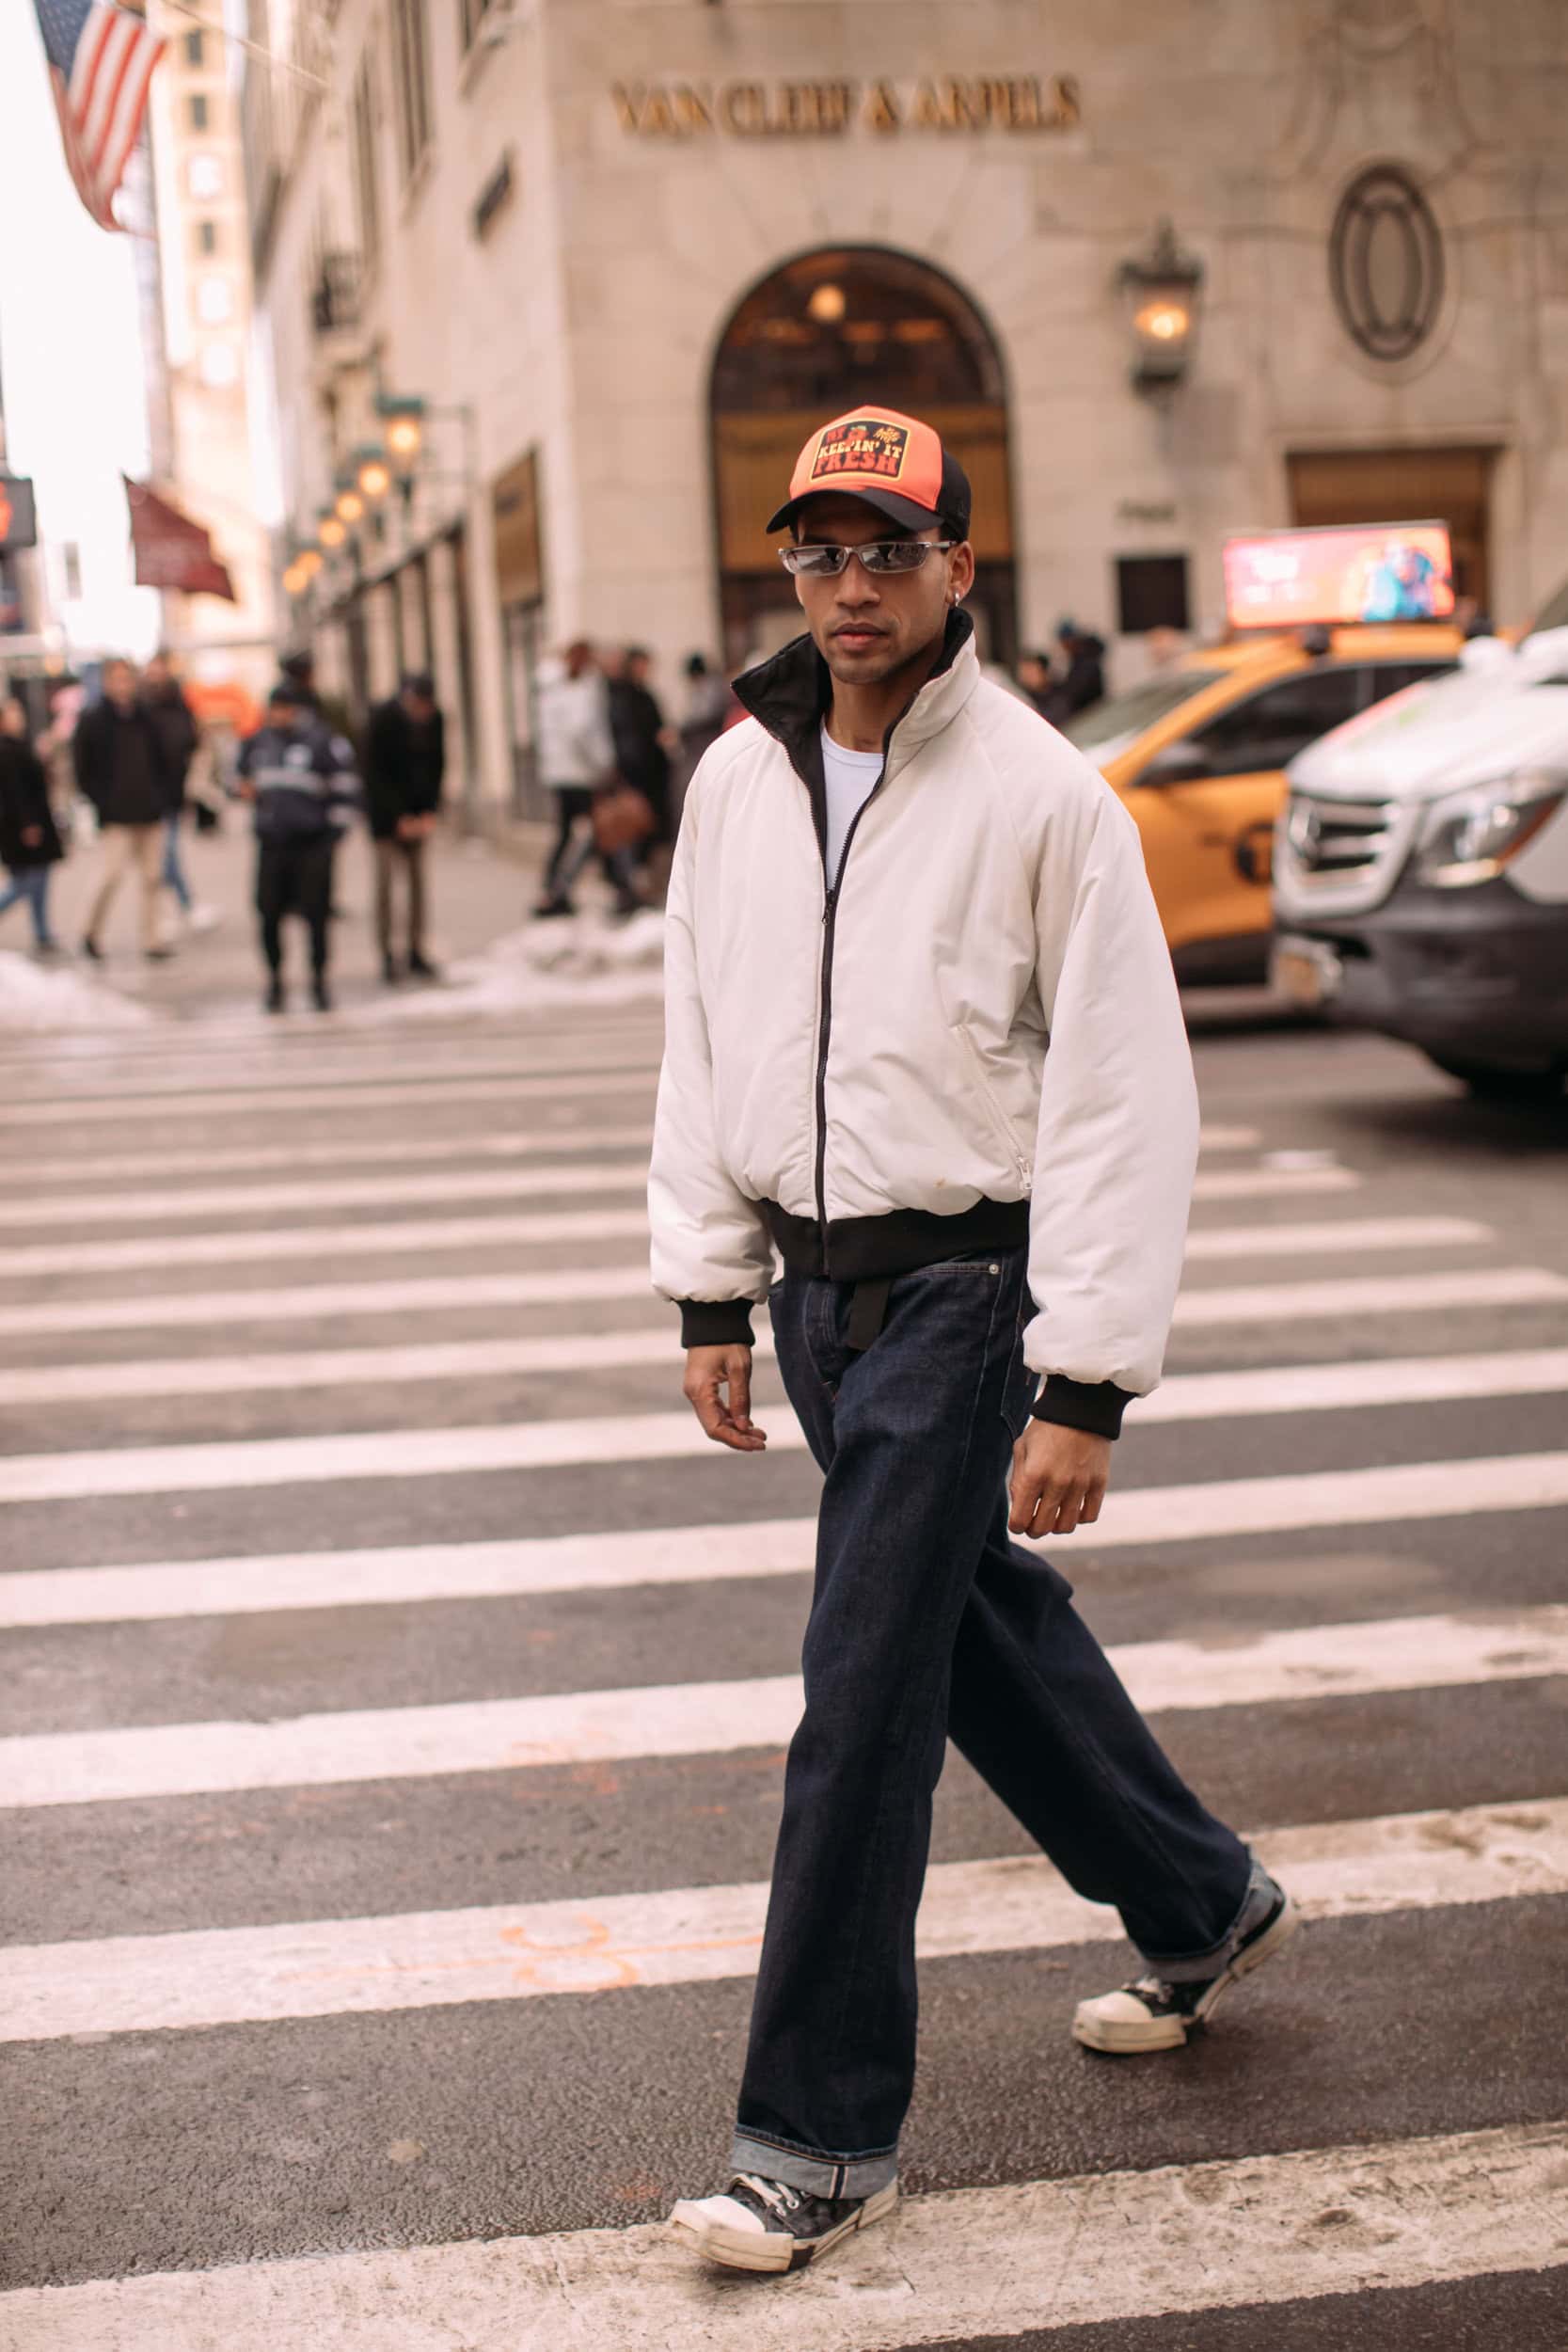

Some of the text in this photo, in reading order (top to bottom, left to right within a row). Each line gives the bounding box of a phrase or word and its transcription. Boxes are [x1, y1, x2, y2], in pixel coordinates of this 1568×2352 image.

[612, 79, 712, 135] VAN
[883, 443, 902, 458] IT
[813, 451, 898, 475] FRESH
